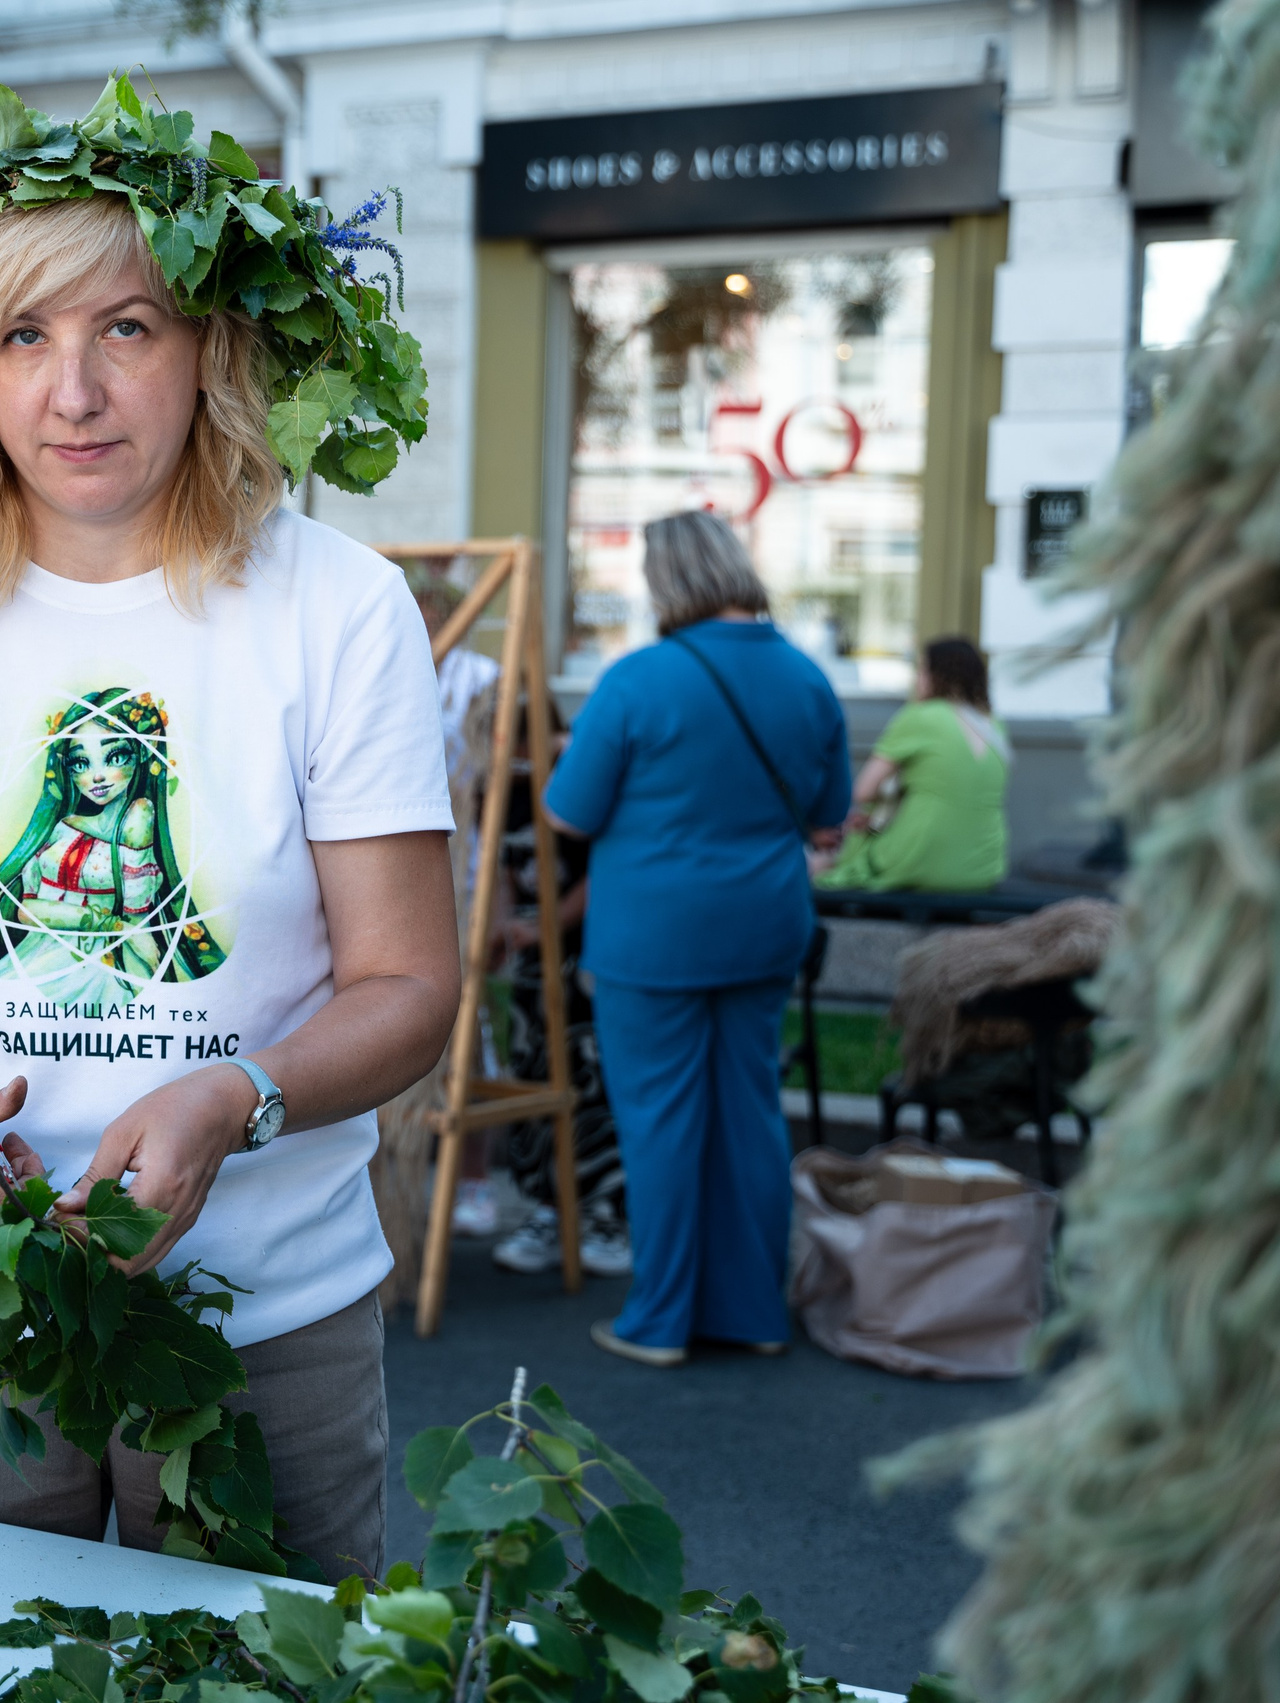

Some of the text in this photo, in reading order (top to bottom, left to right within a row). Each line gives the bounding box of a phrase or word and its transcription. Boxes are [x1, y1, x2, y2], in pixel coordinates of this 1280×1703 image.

[527, 131, 948, 190] SHOES & ACCESSORIES
[6, 1002, 155, 1022] ЗАЩИЩАЕМ
[169, 1009, 208, 1022] тех
[185, 1033, 240, 1060] НАС
